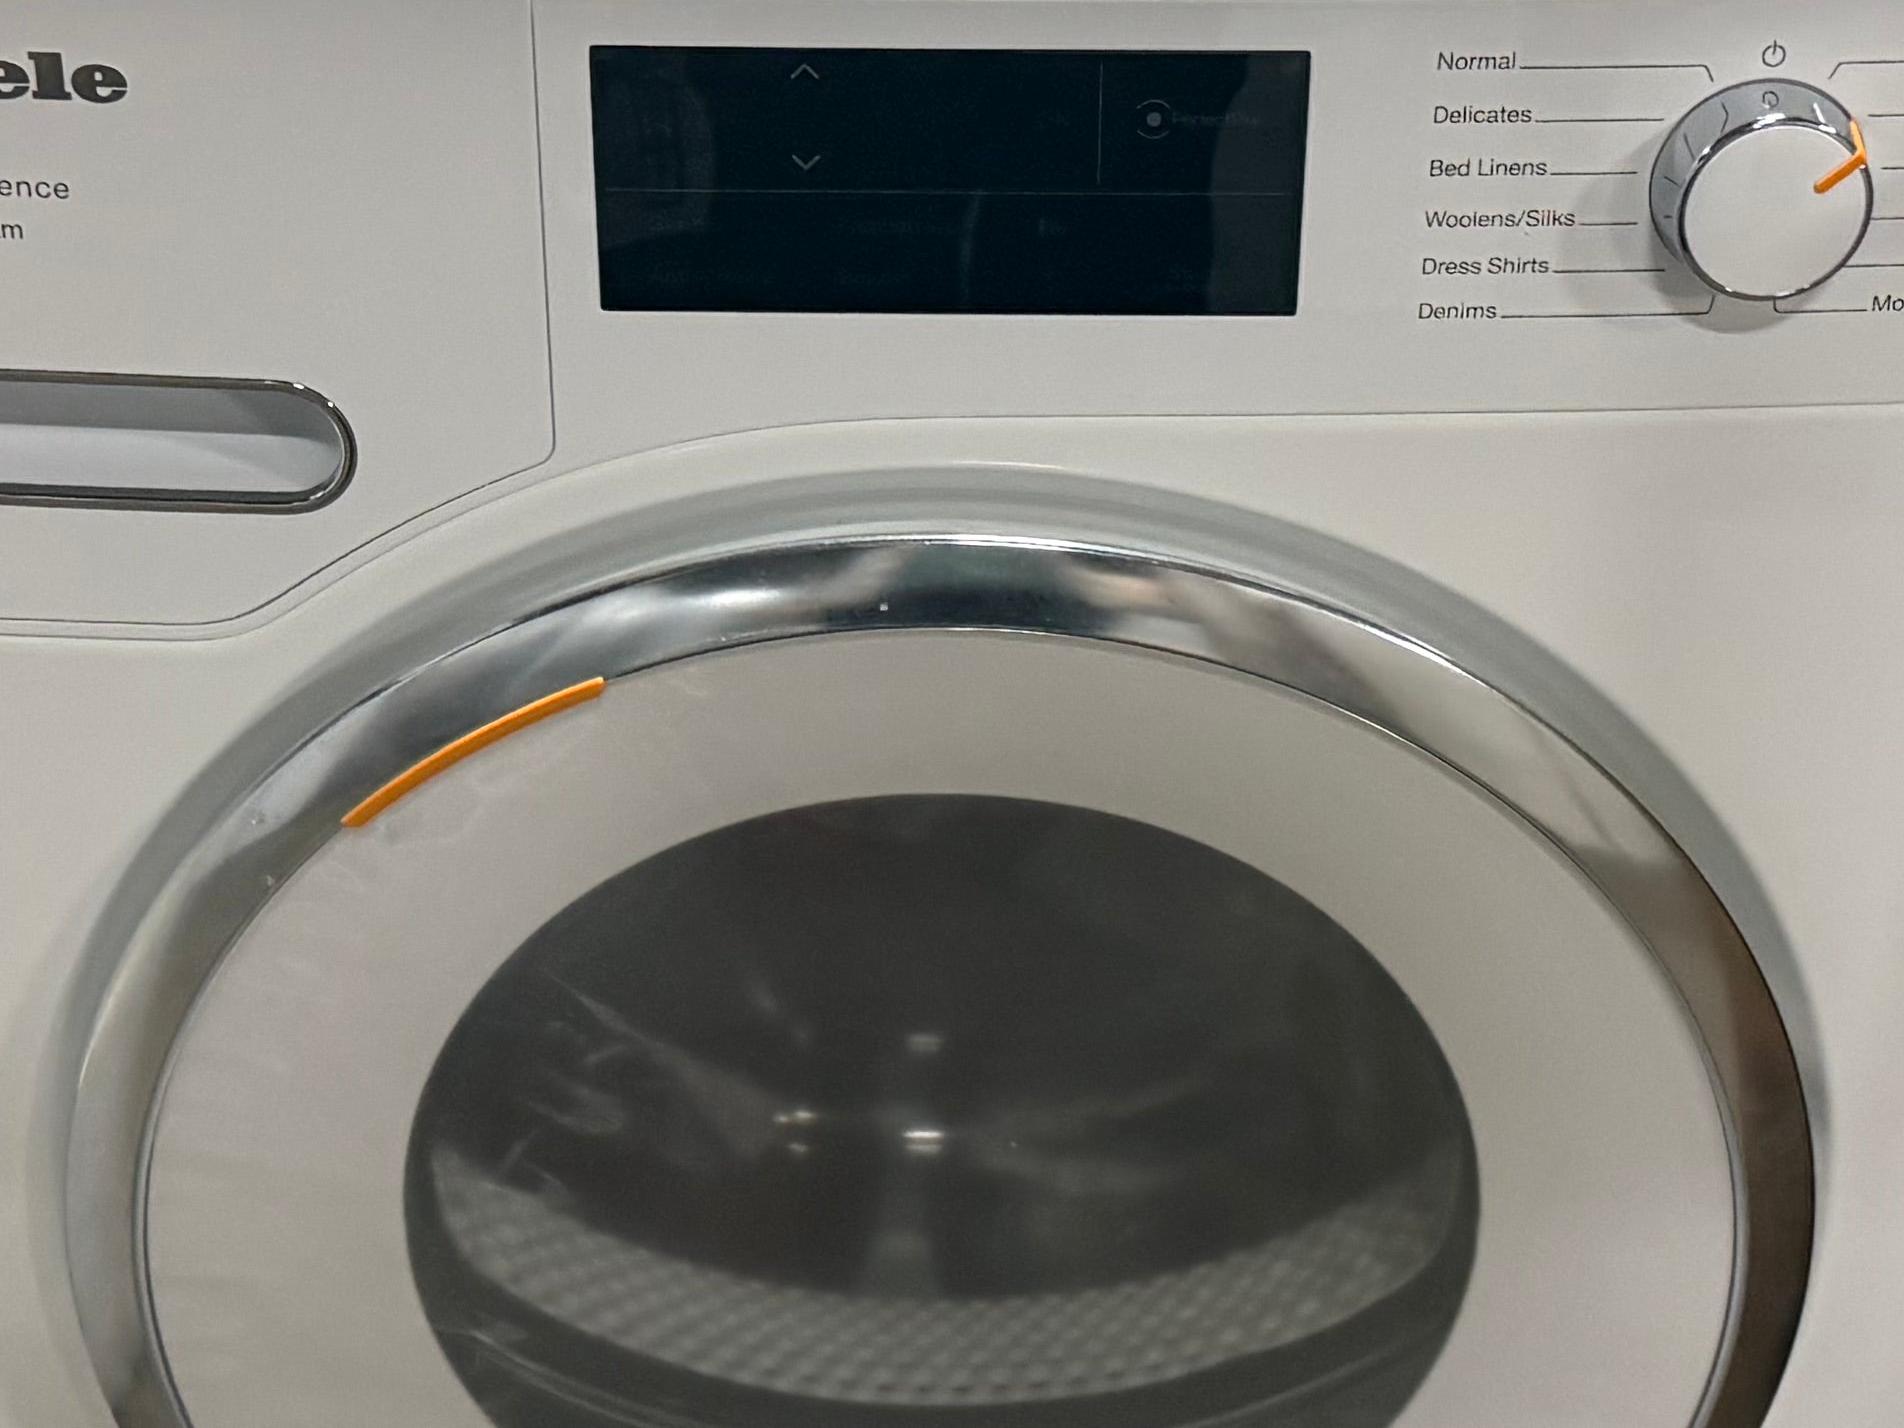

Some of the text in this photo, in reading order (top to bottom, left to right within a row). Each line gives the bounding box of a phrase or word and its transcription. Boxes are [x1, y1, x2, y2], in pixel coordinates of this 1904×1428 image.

[1436, 52, 1517, 70] Normal
[1433, 106, 1533, 124] Delicates
[1429, 158, 1548, 177] Bed Linens
[1425, 210, 1576, 228] Woolens/Silks
[1422, 257, 1550, 275] Dress Shirts
[1418, 303, 1497, 320] Denims
